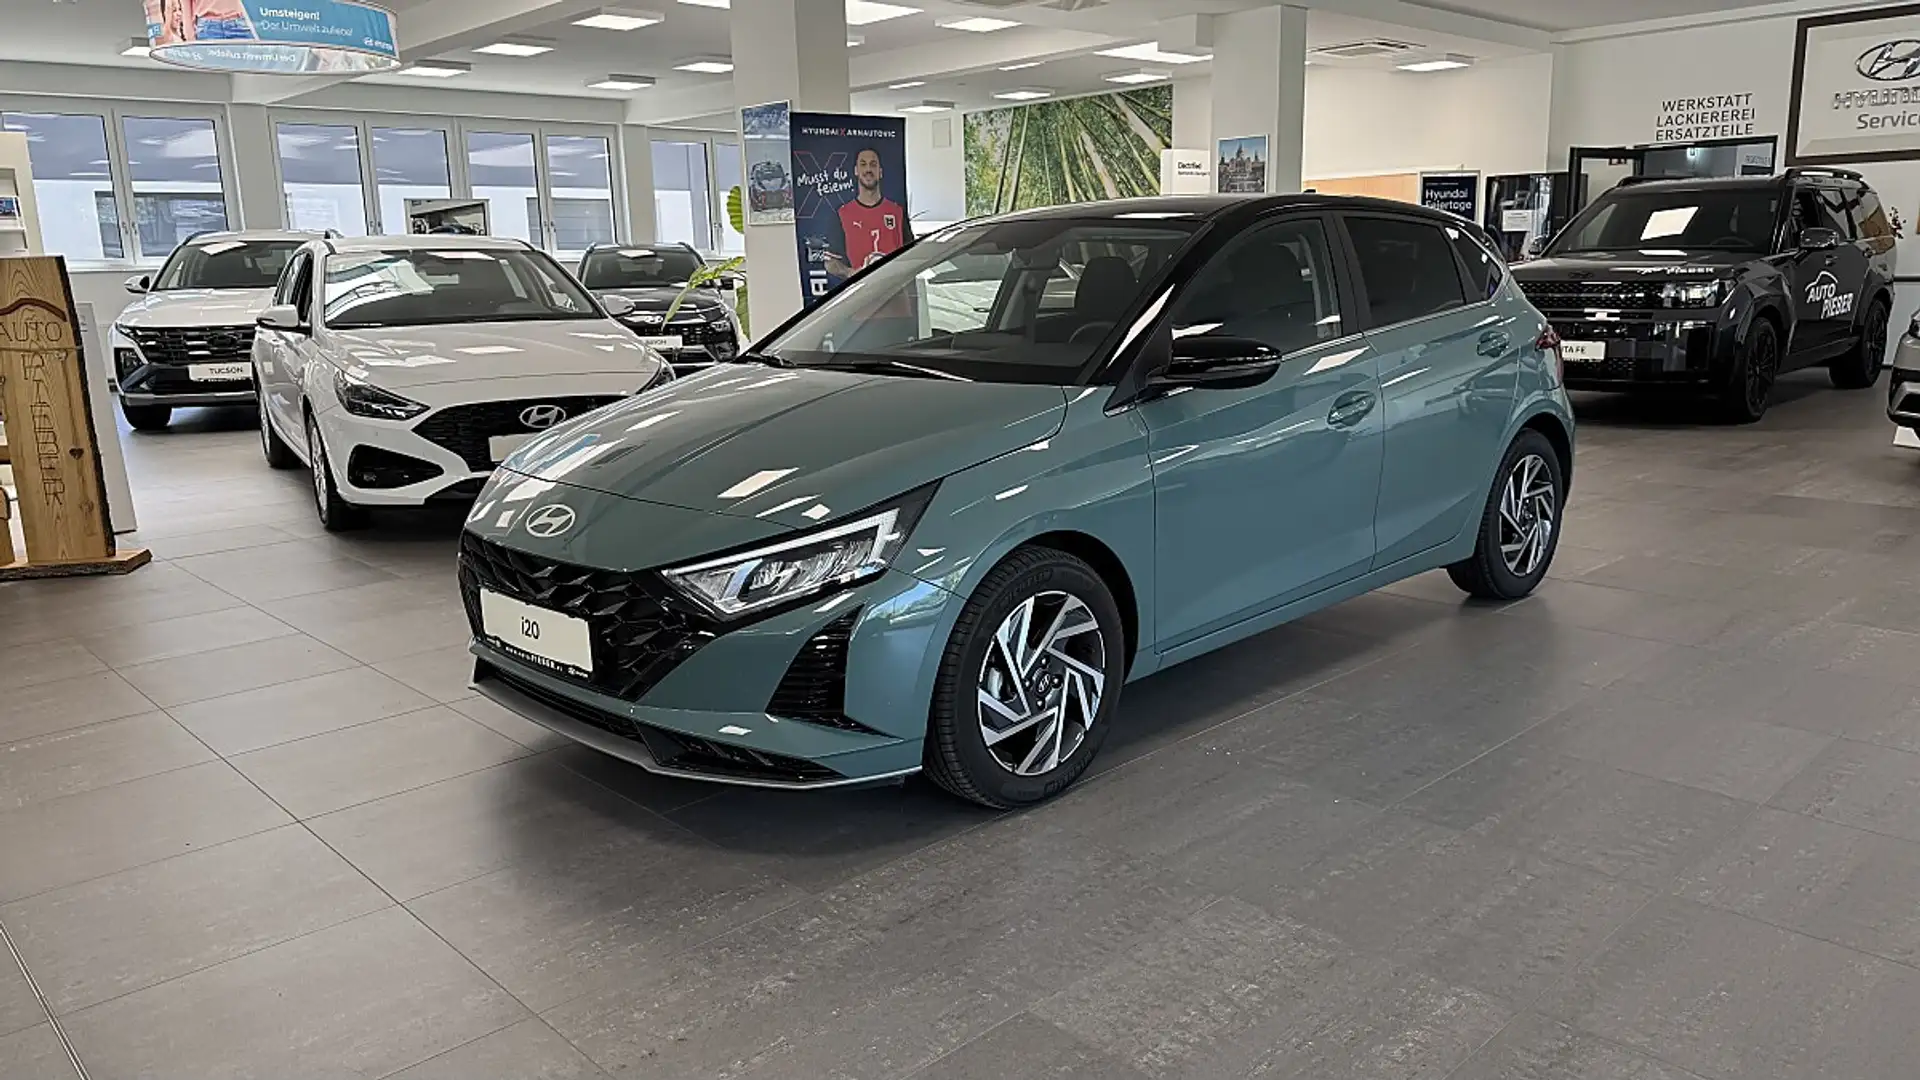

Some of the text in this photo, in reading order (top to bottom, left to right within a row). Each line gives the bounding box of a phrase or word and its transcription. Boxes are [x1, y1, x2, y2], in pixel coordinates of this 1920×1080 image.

[259, 7, 320, 20] Umsteigen!
[1662, 93, 1753, 112] WERKSTATT
[1656, 108, 1755, 127] LACKIEREREI
[1856, 110, 1920, 129] Servic
[801, 127, 838, 136] HYUNDAI
[846, 130, 896, 138] ARNAUTOVIC
[1656, 123, 1754, 141] ERSATZTEILE
[797, 167, 848, 187] Musst du
[1425, 188, 1469, 202] Hyundai
[1806, 283, 1837, 304] AUTO
[208, 366, 244, 375] TUCSON
[521, 616, 541, 640] i20
